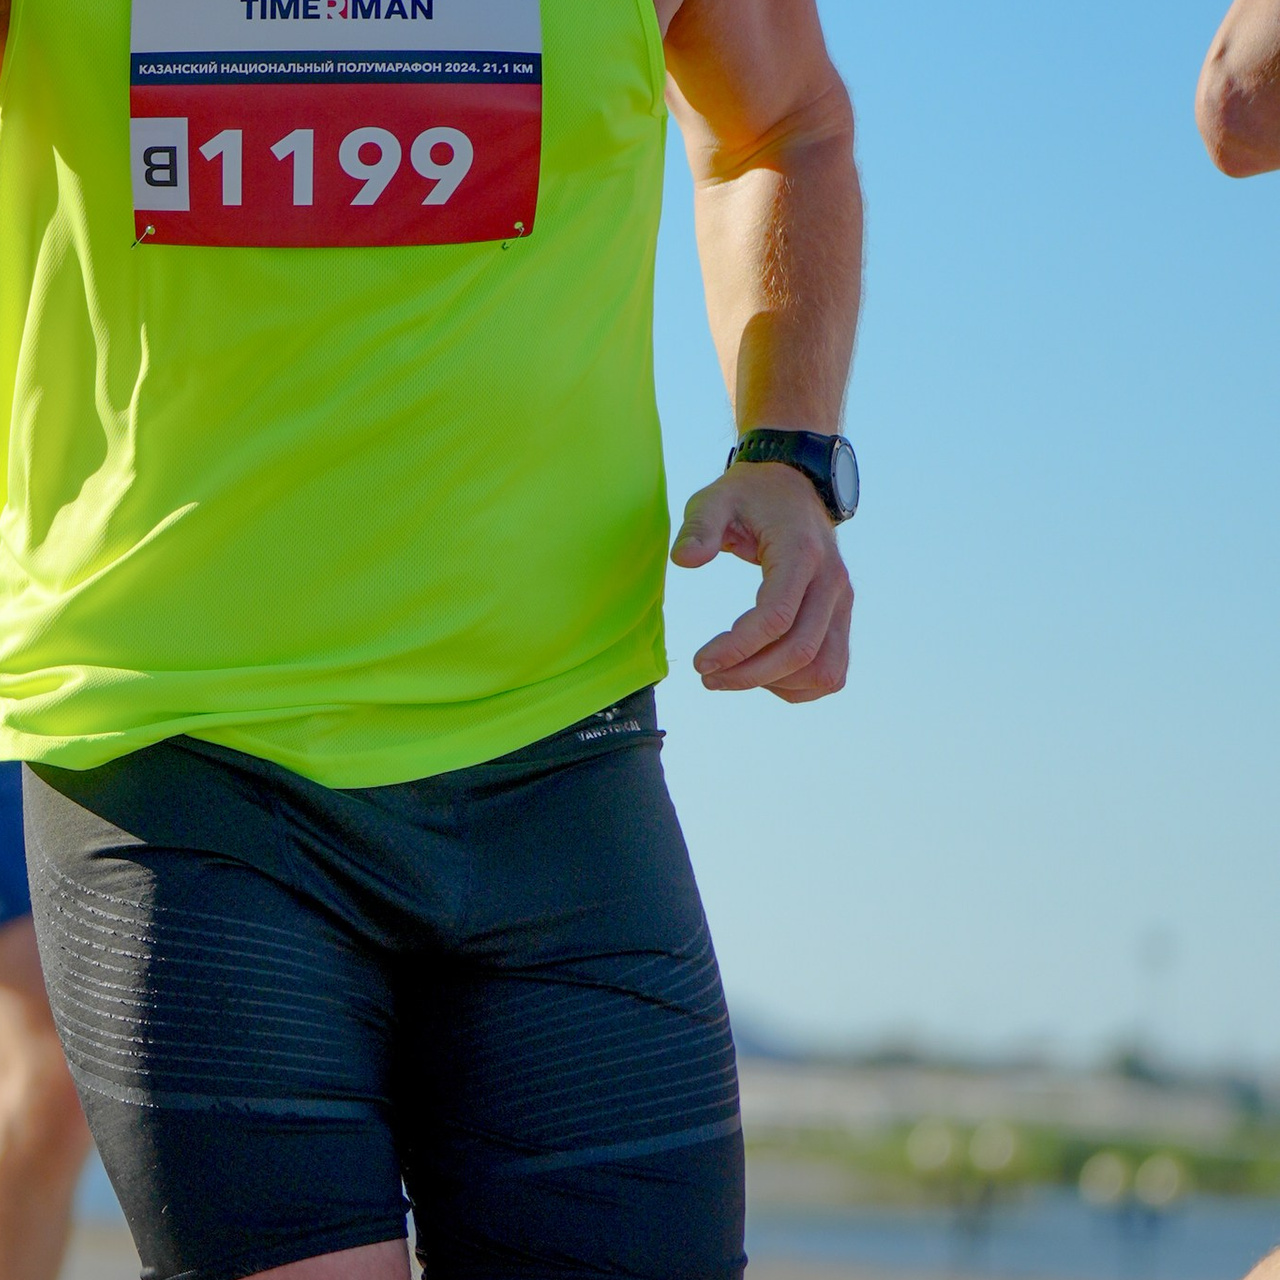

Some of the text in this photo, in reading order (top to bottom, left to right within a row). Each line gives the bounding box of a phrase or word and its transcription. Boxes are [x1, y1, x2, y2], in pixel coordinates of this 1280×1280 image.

[138, 60, 534, 75] КАЗАНСКИЙ НАЦИОНАЛЬНЫЙ ПОЛУМАРАФОН 2024. 21,1 КМ
[199, 126, 474, 206] 1199
